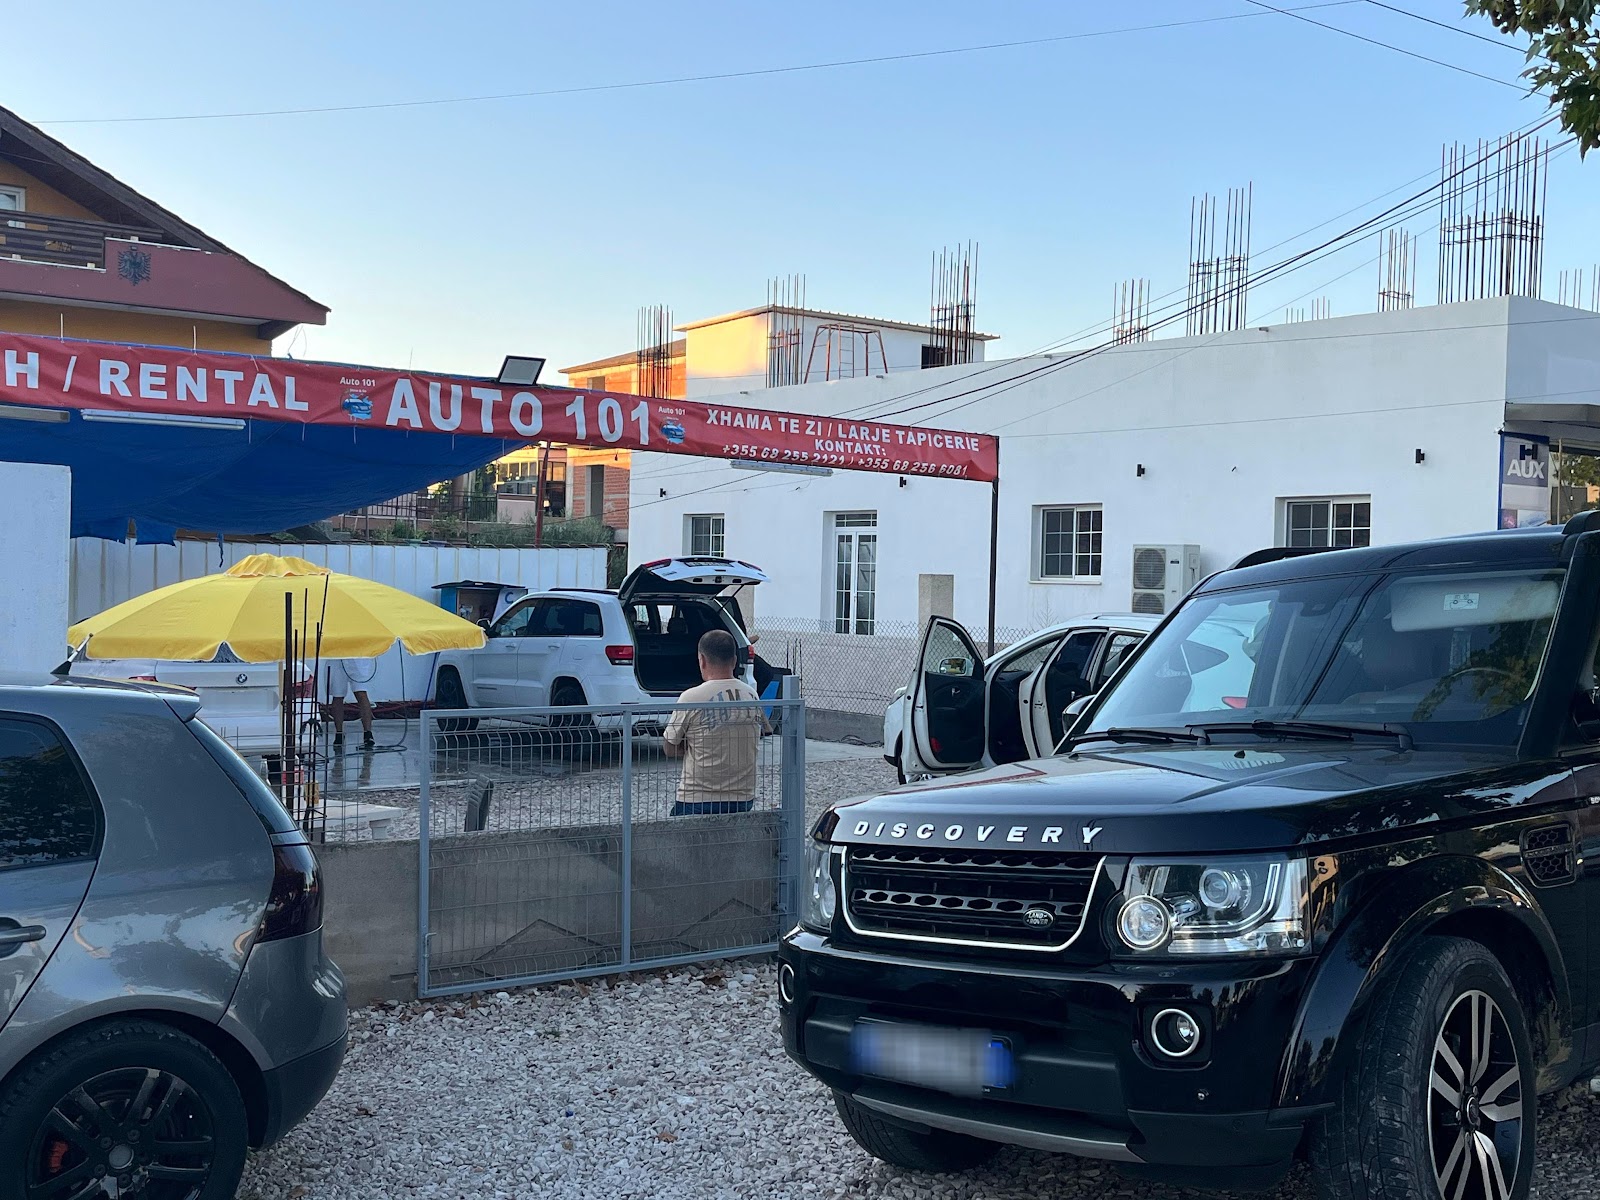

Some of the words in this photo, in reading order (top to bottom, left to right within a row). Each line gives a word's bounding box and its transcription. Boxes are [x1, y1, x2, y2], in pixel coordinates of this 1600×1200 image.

[5, 350, 39, 389] H
[62, 355, 77, 392] /
[99, 359, 310, 412] RENTAL
[340, 376, 360, 386] Auto
[362, 378, 376, 387] 101
[386, 378, 543, 437] AUTO
[565, 395, 649, 445] 101
[658, 406, 674, 414] Auto
[675, 408, 686, 416] 101
[706, 409, 773, 431] XHAMA
[778, 417, 800, 434] TE
[805, 420, 822, 436] ZI
[827, 422, 833, 437] /
[838, 424, 891, 443] LARJE
[896, 430, 980, 452] TAPICERIE
[815, 439, 887, 456] KONTAKT:
[723, 444, 758, 458] +355
[761, 447, 779, 459] 68
[782, 449, 809, 461] 255
[812, 452, 845, 465] 2121
[858, 457, 890, 470] +355
[893, 460, 909, 471] 68
[911, 461, 936, 474] 256
[939, 464, 968, 476] 6081
[1507, 459, 1545, 479] AUX
[854, 821, 1102, 844] DISCOVERY
